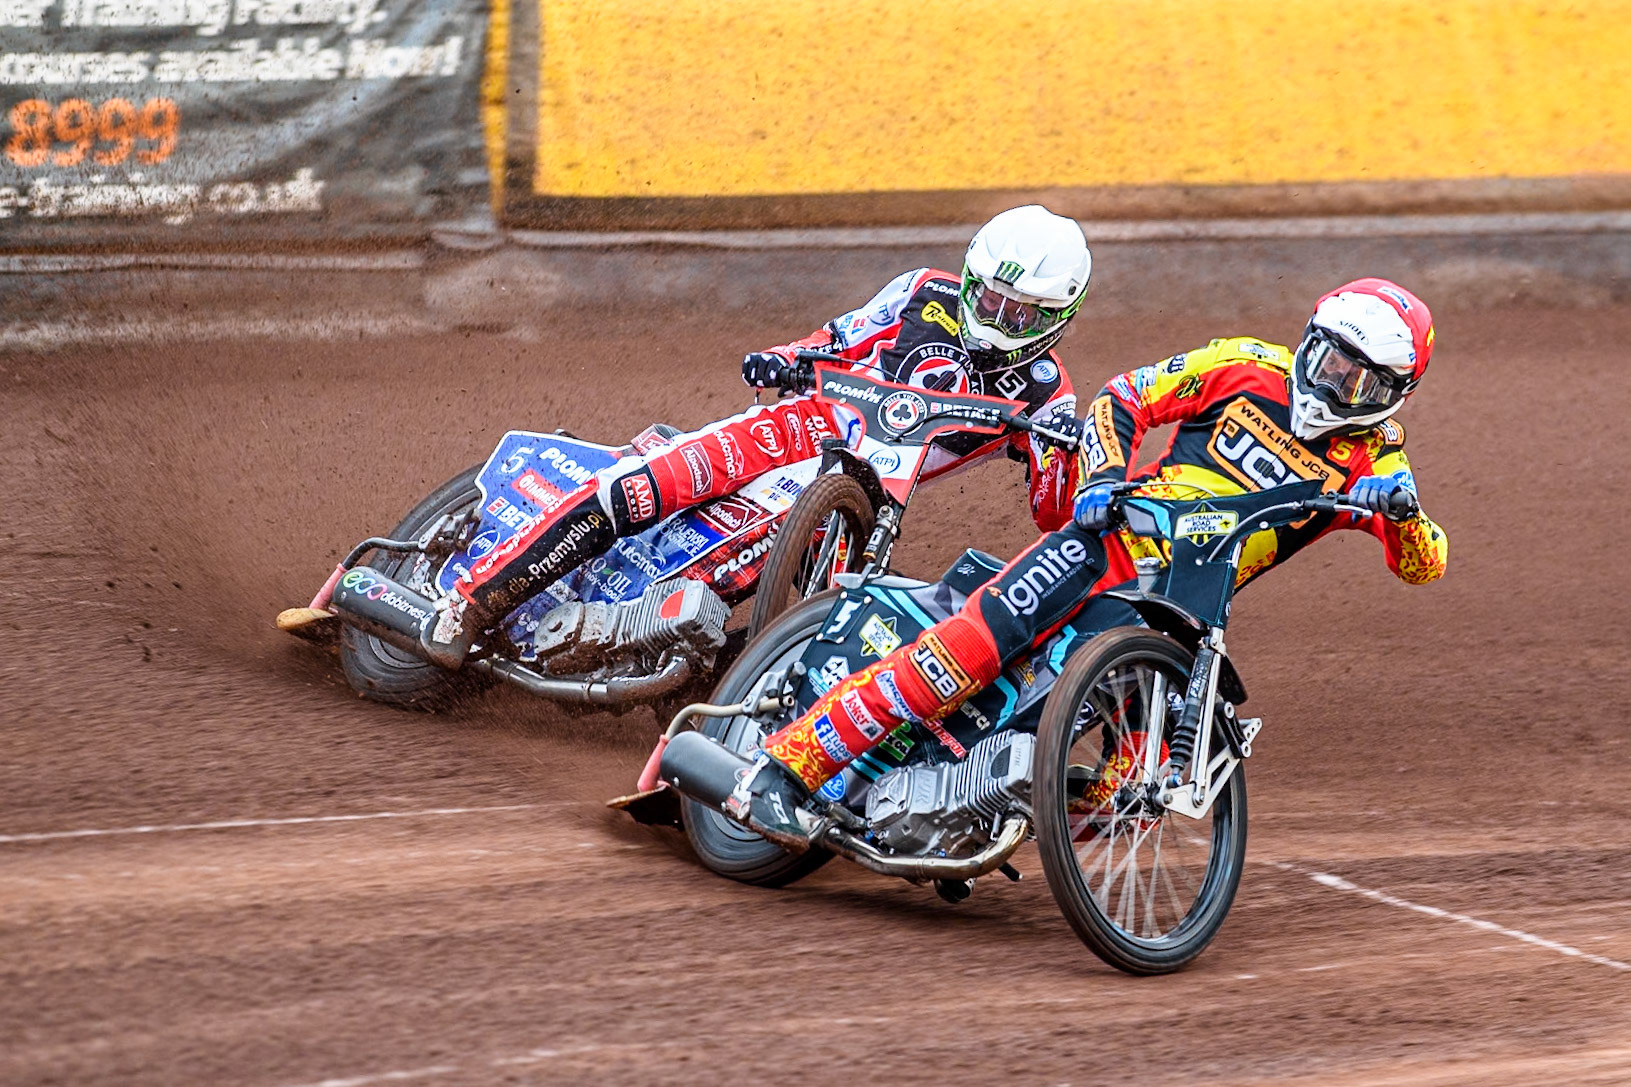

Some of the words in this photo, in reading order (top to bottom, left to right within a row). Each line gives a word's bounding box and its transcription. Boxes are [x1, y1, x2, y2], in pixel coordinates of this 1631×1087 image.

[5, 98, 182, 166] 8999
[919, 346, 955, 359] BELLE
[760, 425, 779, 451] ATPI
[1240, 405, 1301, 460] WATLING
[1301, 459, 1331, 480] JCB
[1331, 440, 1356, 461] 5
[872, 455, 896, 468] ATPI
[632, 477, 653, 518] AMD
[914, 647, 958, 698] JCB
[843, 691, 870, 725] Joker
